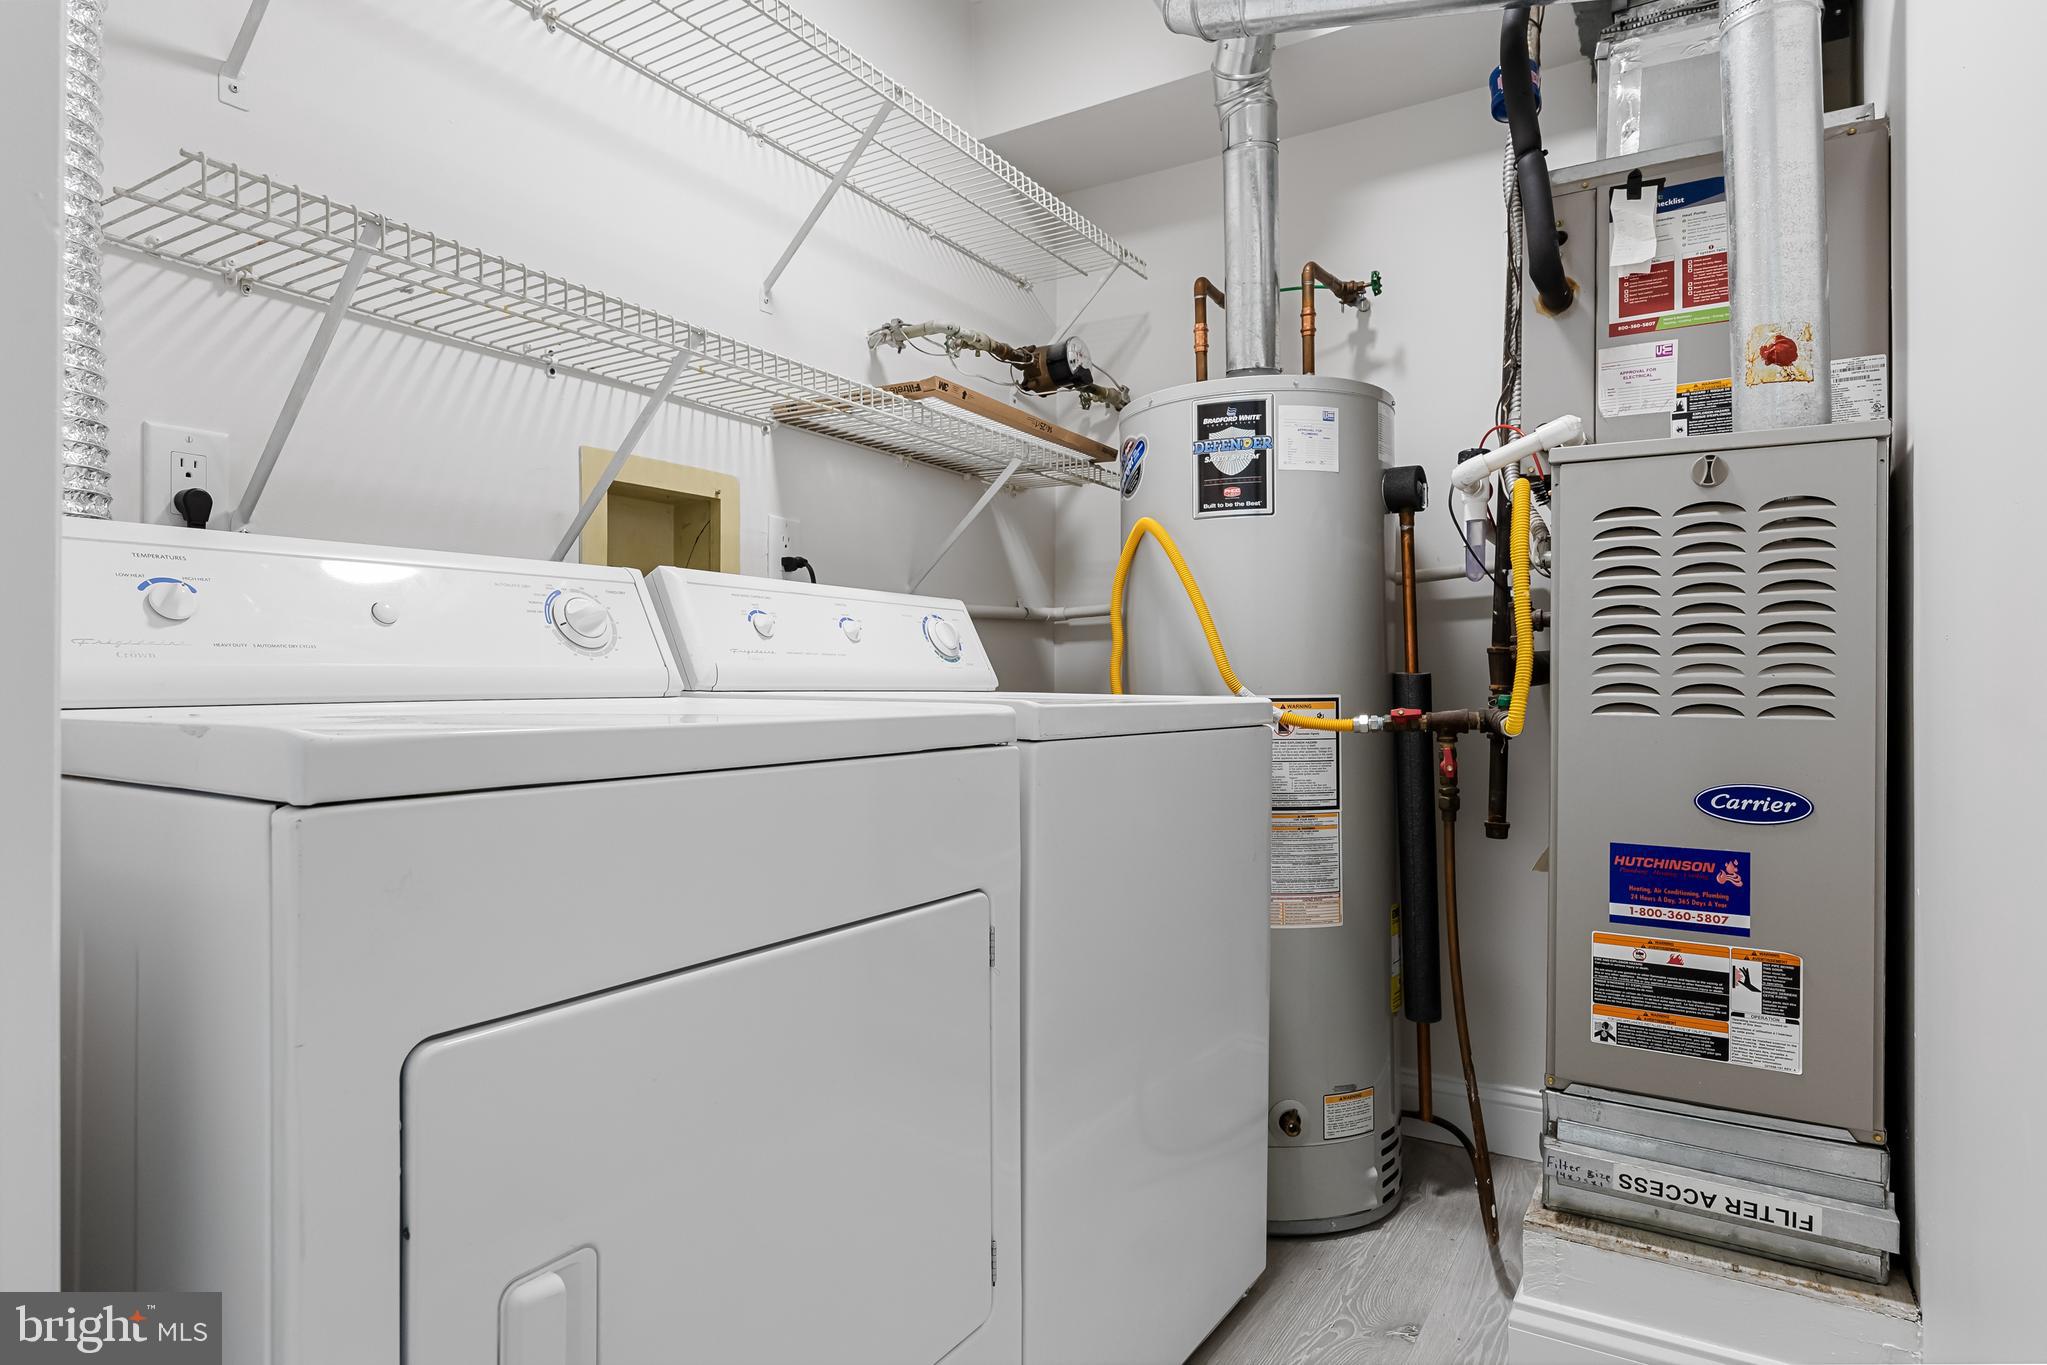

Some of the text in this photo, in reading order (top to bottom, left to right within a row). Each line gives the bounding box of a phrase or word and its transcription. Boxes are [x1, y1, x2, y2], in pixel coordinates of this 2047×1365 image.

[1619, 368, 1645, 376] APPROVAL
[1622, 373, 1653, 381] ELECTRICAL
[938, 381, 950, 393] 3M
[1202, 415, 1238, 425] BRADFORD
[1193, 436, 1274, 455] DEFENDER
[131, 552, 187, 561] TEMPERATURES
[1710, 793, 1797, 814] Carrier
[1613, 855, 1716, 874] HUTCHINSON
[1628, 885, 1652, 894] Heating,
[1663, 888, 1700, 899] Conditioning,
[1702, 891, 1729, 901] Plumbing
[1639, 894, 1656, 902] Hours
[1691, 899, 1706, 908] Days
[1629, 906, 1729, 925] 1-800-360-5807
[1750, 1014, 1780, 1023] OPERATION
[1546, 1155, 1581, 1172] Filter
[1617, 1173, 1814, 1232] FILTER ACCESS
